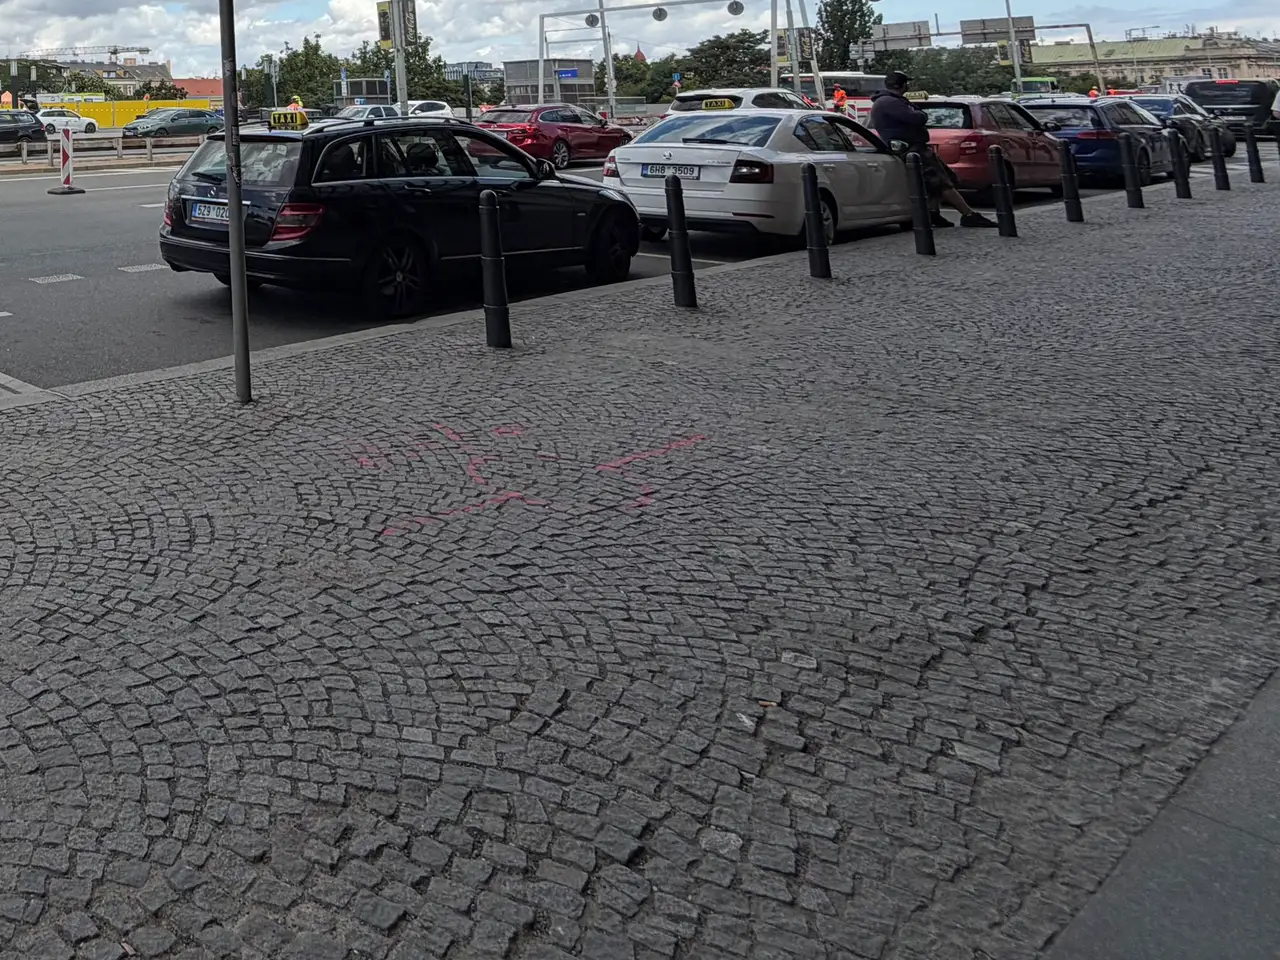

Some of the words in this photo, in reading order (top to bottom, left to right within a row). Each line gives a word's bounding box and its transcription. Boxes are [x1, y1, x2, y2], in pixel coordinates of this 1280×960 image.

[274, 114, 296, 123] TAXI
[649, 165, 666, 174] 6H8
[672, 166, 695, 175] 3509
